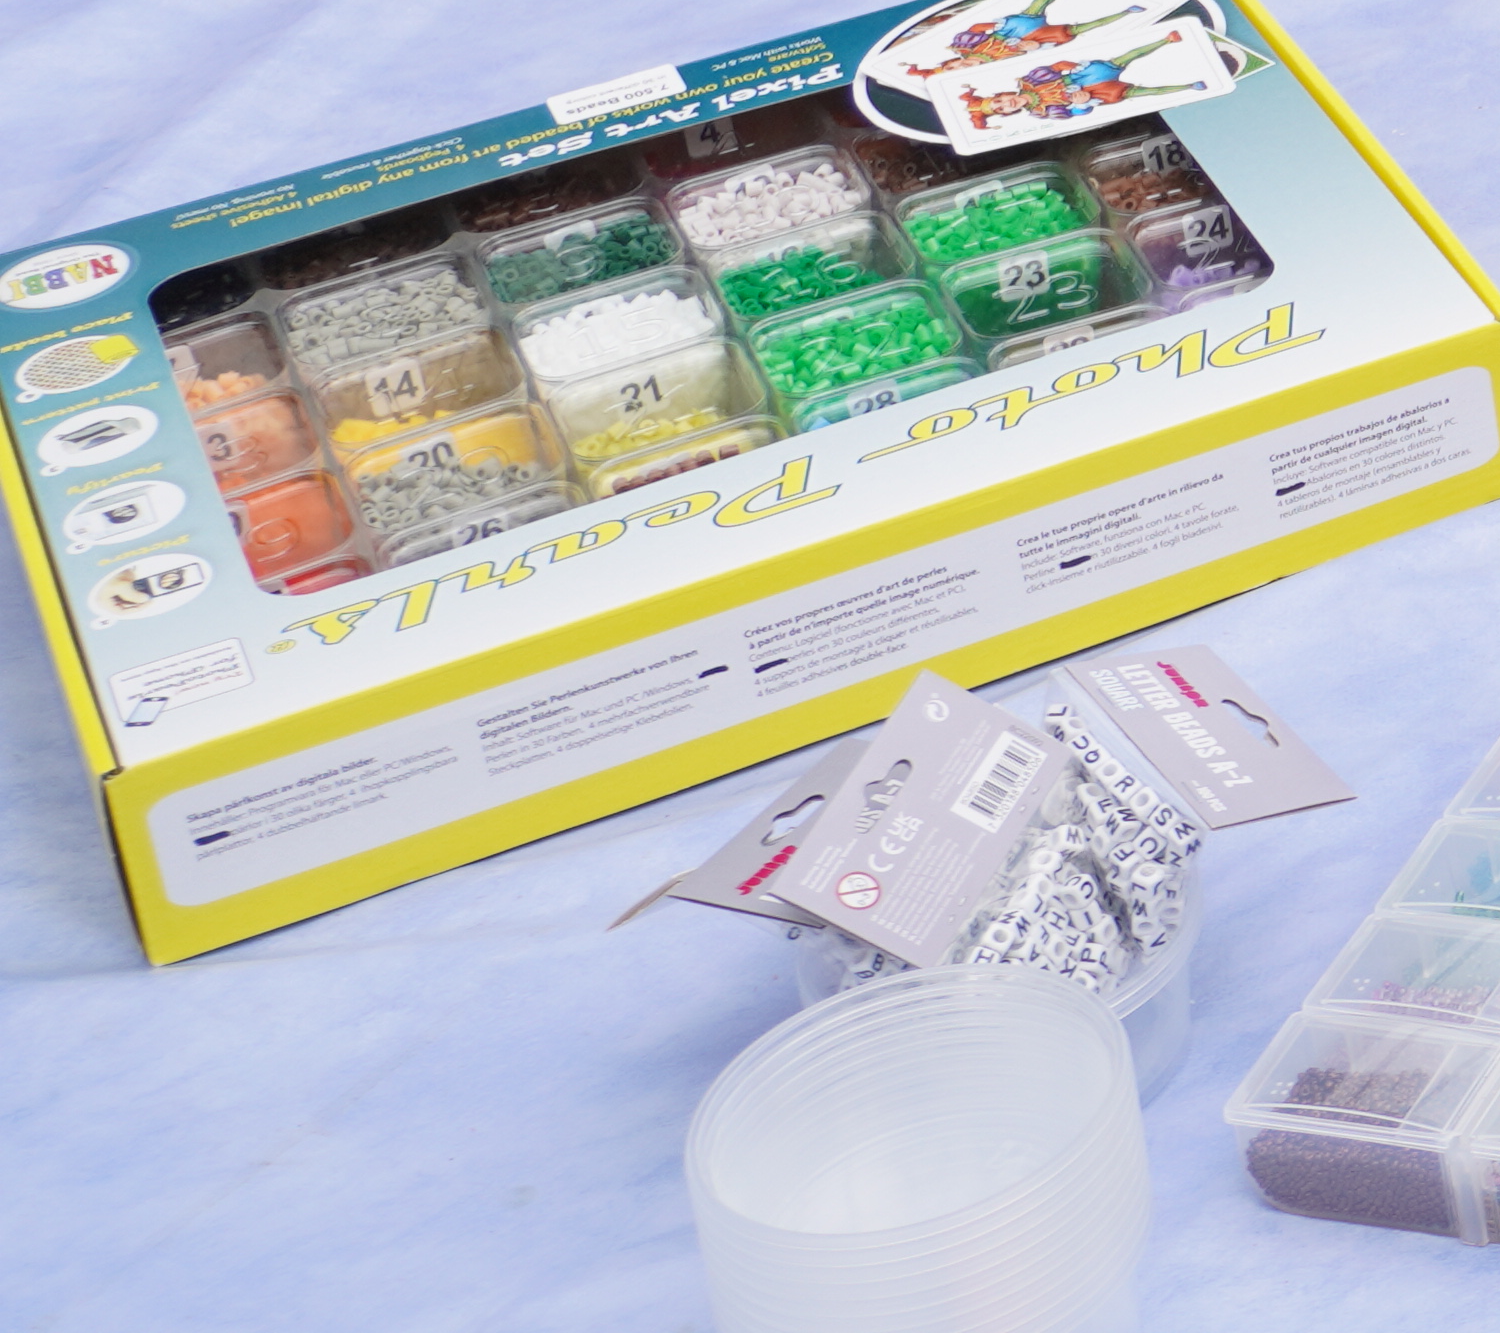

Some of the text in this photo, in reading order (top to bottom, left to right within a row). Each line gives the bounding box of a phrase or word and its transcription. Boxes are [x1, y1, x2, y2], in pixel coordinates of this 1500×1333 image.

[711, 61, 727, 71] PC
[767, 42, 825, 62] Software
[770, 51, 833, 74] Create
[674, 83, 718, 100] own
[711, 63, 843, 111] Pixel
[723, 67, 767, 87] your
[565, 95, 619, 116] Beads
[585, 113, 608, 128] of
[603, 101, 700, 137] Art
[611, 96, 671, 118] works
[471, 143, 501, 158] art
[497, 130, 593, 167] Set
[505, 119, 584, 150] beaded
[376, 147, 451, 172] Pegboards
[418, 153, 469, 172] from
[1148, 140, 1186, 172] 18
[377, 167, 414, 184] any
[219, 193, 284, 216] Adhesive
[306, 179, 373, 206] digital
[229, 200, 302, 227] image!
[1188, 212, 1230, 248] 24
[8, 252, 120, 302] NABBI
[1004, 260, 1046, 288] 23
[620, 374, 665, 413] 21
[1269, 451, 1291, 463] Crea
[1291, 445, 1308, 455] tus
[1308, 433, 1345, 451] propios
[1346, 419, 1385, 437] trabajos
[1386, 414, 1399, 424] de
[1400, 400, 1443, 419] abalorios
[1271, 415, 1428, 476] partir de cualquier imagen digital.
[283, 303, 1326, 645] Photo Pearls
[1016, 535, 1040, 547] Crea
[1040, 531, 1051, 540] le
[1051, 525, 1069, 536] tue
[1070, 513, 1107, 532] proprie
[1108, 503, 1137, 517] opere
[1168, 488, 1178, 497] in
[1179, 478, 1210, 493] rilievo
[1211, 473, 1224, 482] da
[1018, 513, 1141, 559] tutte le immagini digitali.
[743, 624, 774, 639] Créez
[774, 617, 793, 628] vos
[794, 604, 835, 624] propres
[901, 577, 915, 586] de
[916, 566, 948, 583] perles
[757, 632, 787, 649] partir
[788, 627, 802, 637] de
[855, 599, 887, 615] quelle
[888, 588, 921, 603] image
[922, 569, 980, 592] numérique.
[476, 649, 698, 728] Gestalten Sie Perlenkunstwerke von Ihren
[1089, 668, 1145, 712] SQUARE
[479, 705, 573, 740] digitalen Bildern.
[1116, 663, 1255, 790] LETTER BEADS A-Z
[186, 807, 223, 824] Skapa
[280, 783, 294, 793] av
[295, 769, 340, 788] digitala
[340, 757, 378, 773] bilder.
